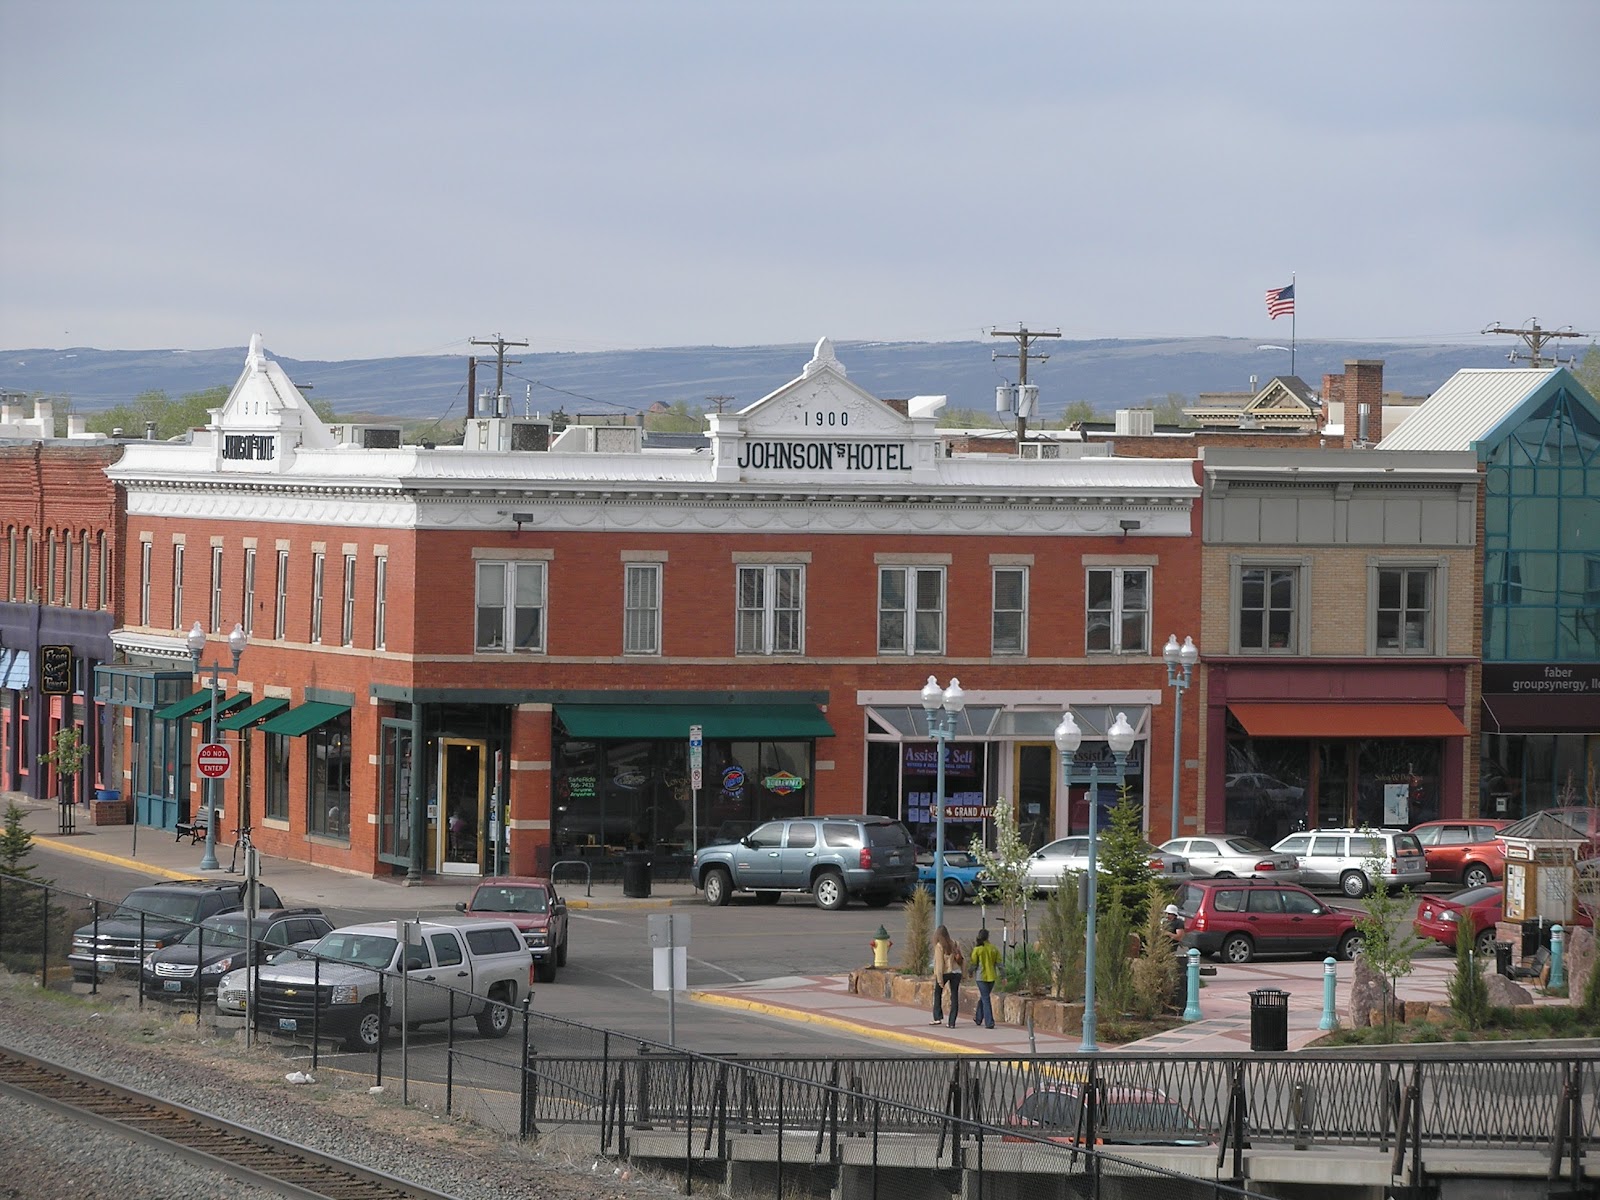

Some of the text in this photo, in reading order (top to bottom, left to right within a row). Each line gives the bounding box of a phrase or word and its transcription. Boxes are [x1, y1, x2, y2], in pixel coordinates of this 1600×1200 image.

[804, 411, 849, 426] 1900
[737, 442, 912, 471] JOHNSON'S HOTEL
[1544, 666, 1573, 678] faber
[1512, 680, 1589, 692] groupsynergy,
[905, 747, 938, 762] Assist
[953, 749, 973, 763] Sell
[954, 806, 993, 817] GRAND AVE
